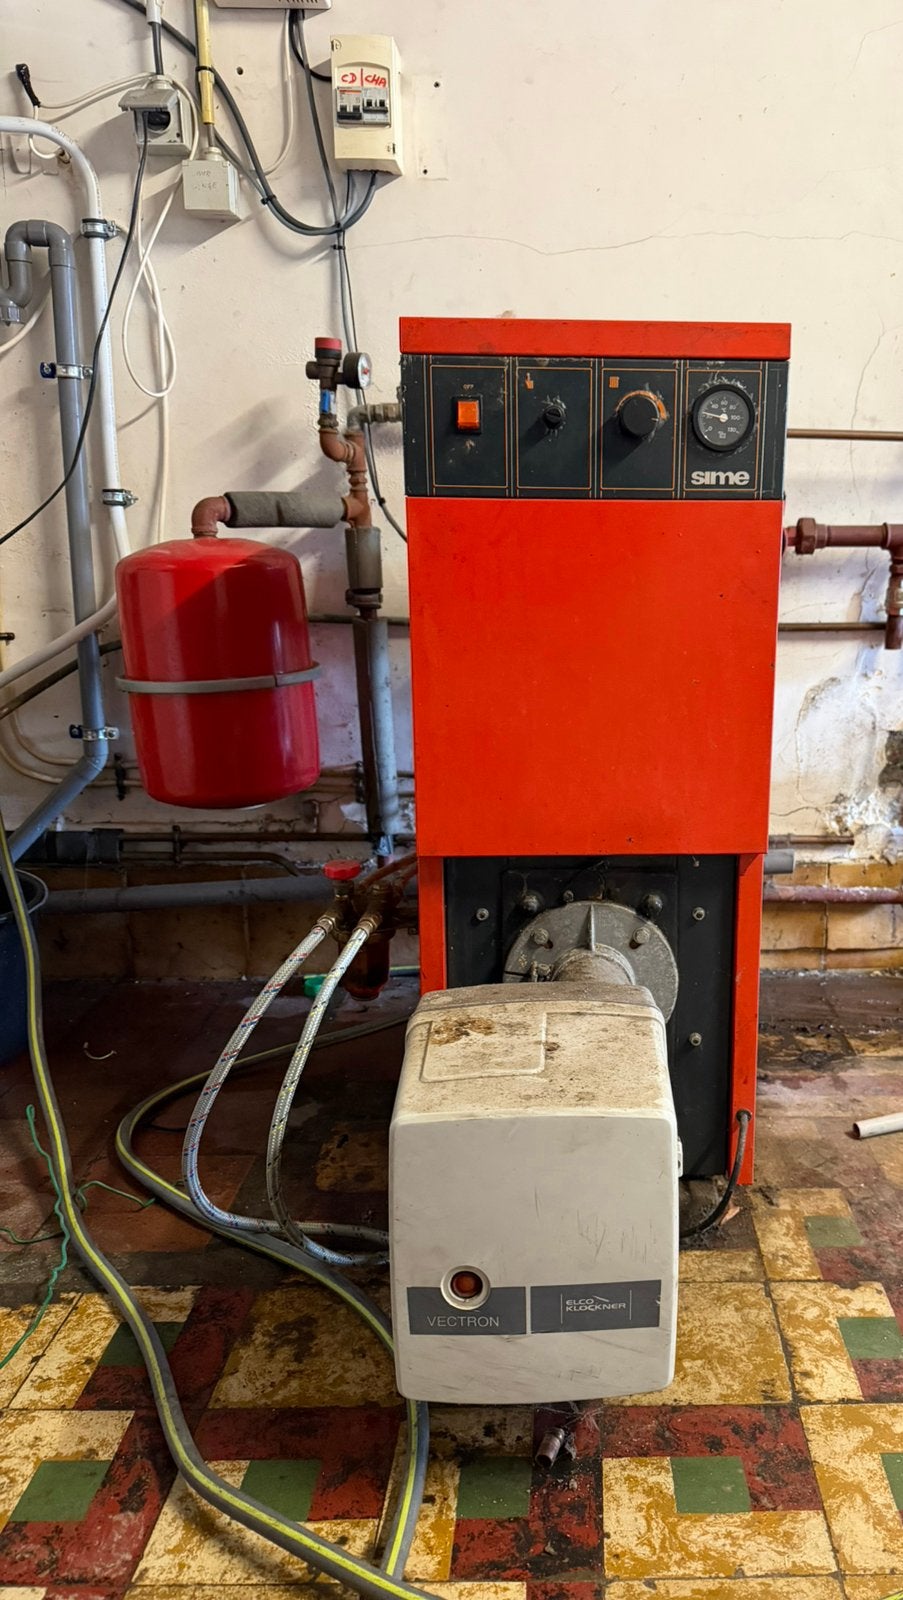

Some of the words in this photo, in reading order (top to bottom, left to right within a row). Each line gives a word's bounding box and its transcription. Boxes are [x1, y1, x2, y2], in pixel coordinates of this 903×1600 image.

[364, 74, 387, 88] CHA
[690, 470, 750, 486] sime
[565, 1298, 595, 1306] ELCO
[426, 1315, 500, 1327] VECTRON
